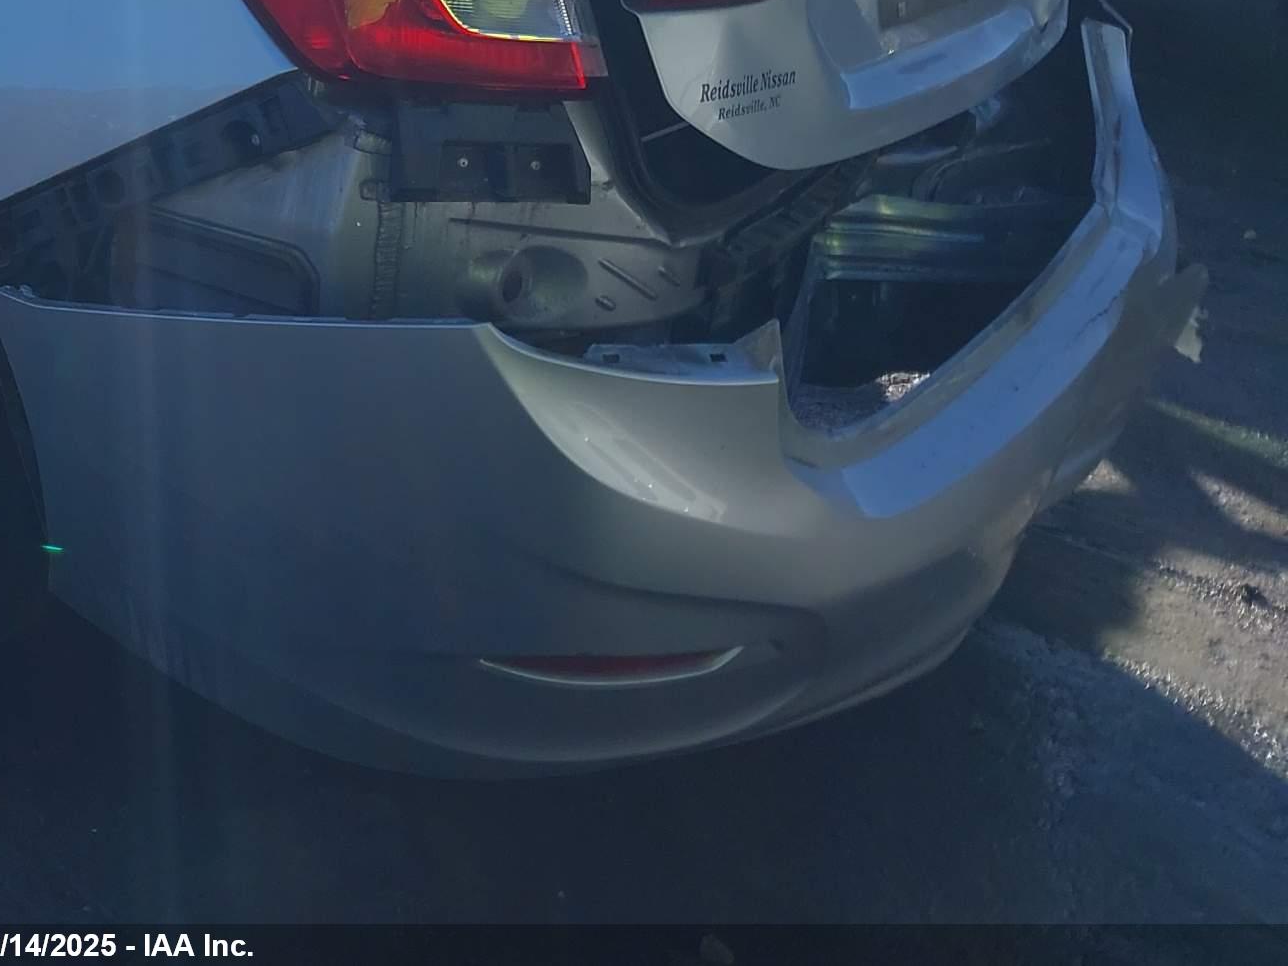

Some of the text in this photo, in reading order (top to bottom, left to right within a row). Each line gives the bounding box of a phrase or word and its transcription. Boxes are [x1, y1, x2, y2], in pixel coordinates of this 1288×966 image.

[700, 70, 796, 102] Reidsville Nissan
[718, 96, 781, 120] Reidsville, NC
